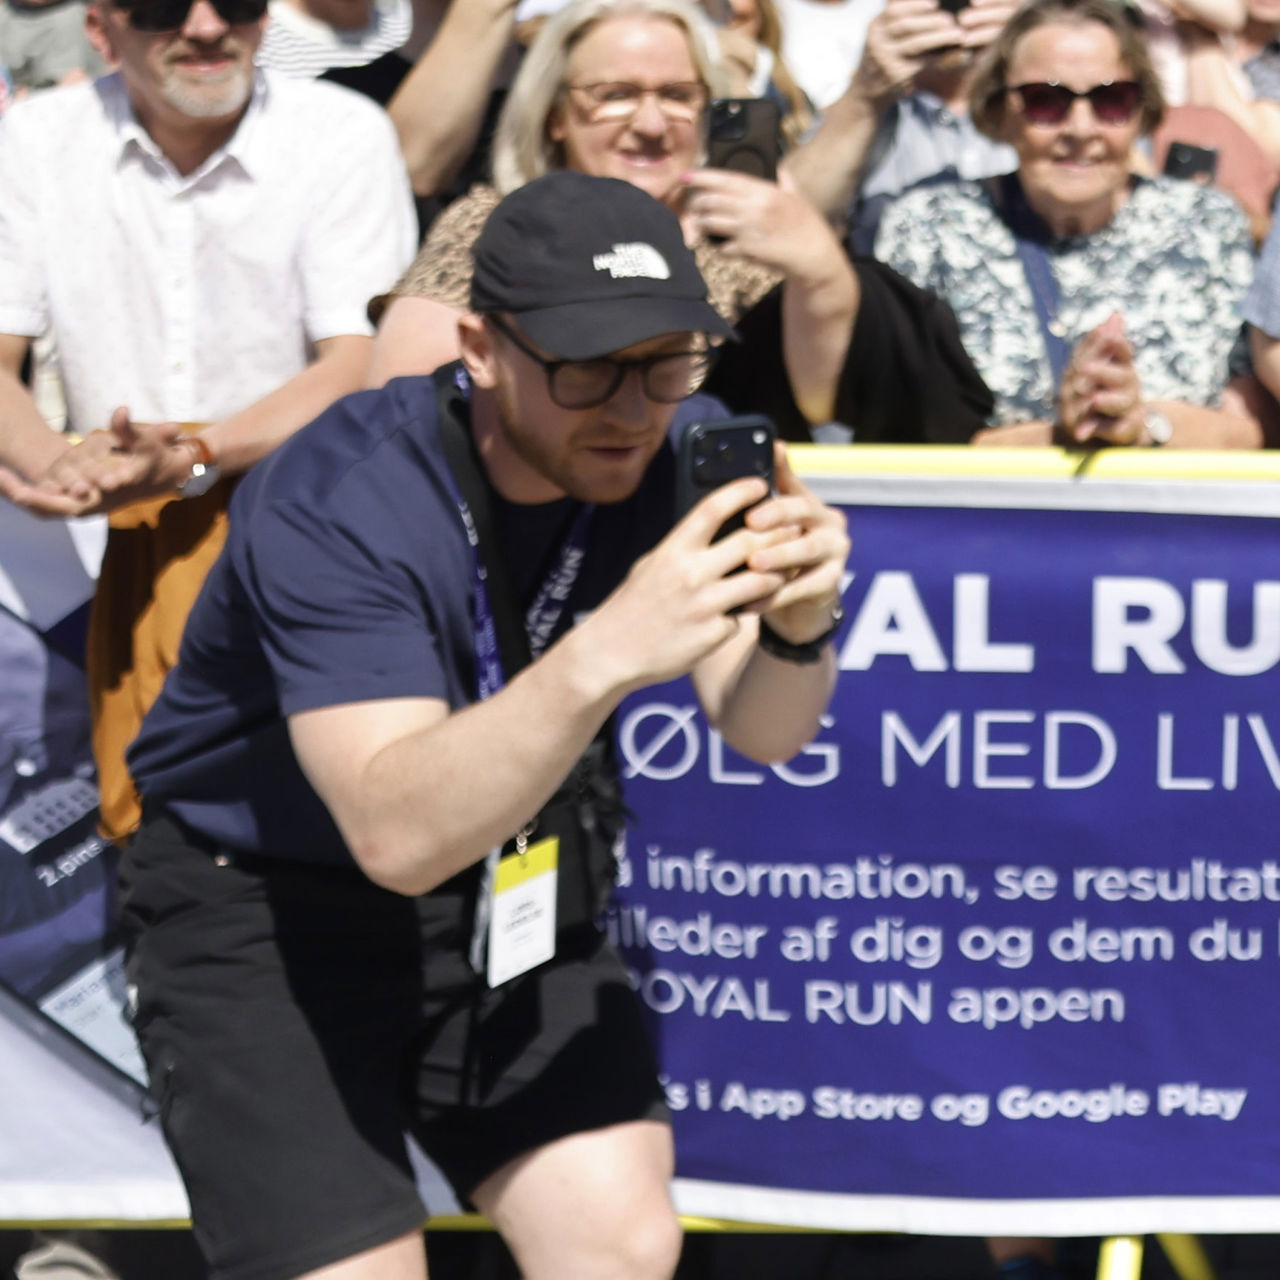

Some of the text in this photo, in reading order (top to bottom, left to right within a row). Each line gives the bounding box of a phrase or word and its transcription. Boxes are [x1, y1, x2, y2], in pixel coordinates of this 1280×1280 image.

[836, 570, 1034, 673] AL
[881, 710, 1118, 790] MED
[647, 844, 980, 904] information,
[994, 867, 1058, 902] se
[597, 904, 768, 960] illeder
[780, 916, 838, 963] af
[850, 917, 943, 970] dig
[958, 926, 1034, 970] og
[1048, 919, 1175, 964] dem
[1188, 919, 1263, 963] du
[626, 968, 1126, 1031] OYAL RUN appen
[695, 1078, 711, 1111] i
[720, 1081, 806, 1121] App
[812, 1084, 924, 1121] Store
[930, 1092, 990, 1127] og
[996, 1082, 1151, 1124] Google
[1157, 1081, 1248, 1122] Play
